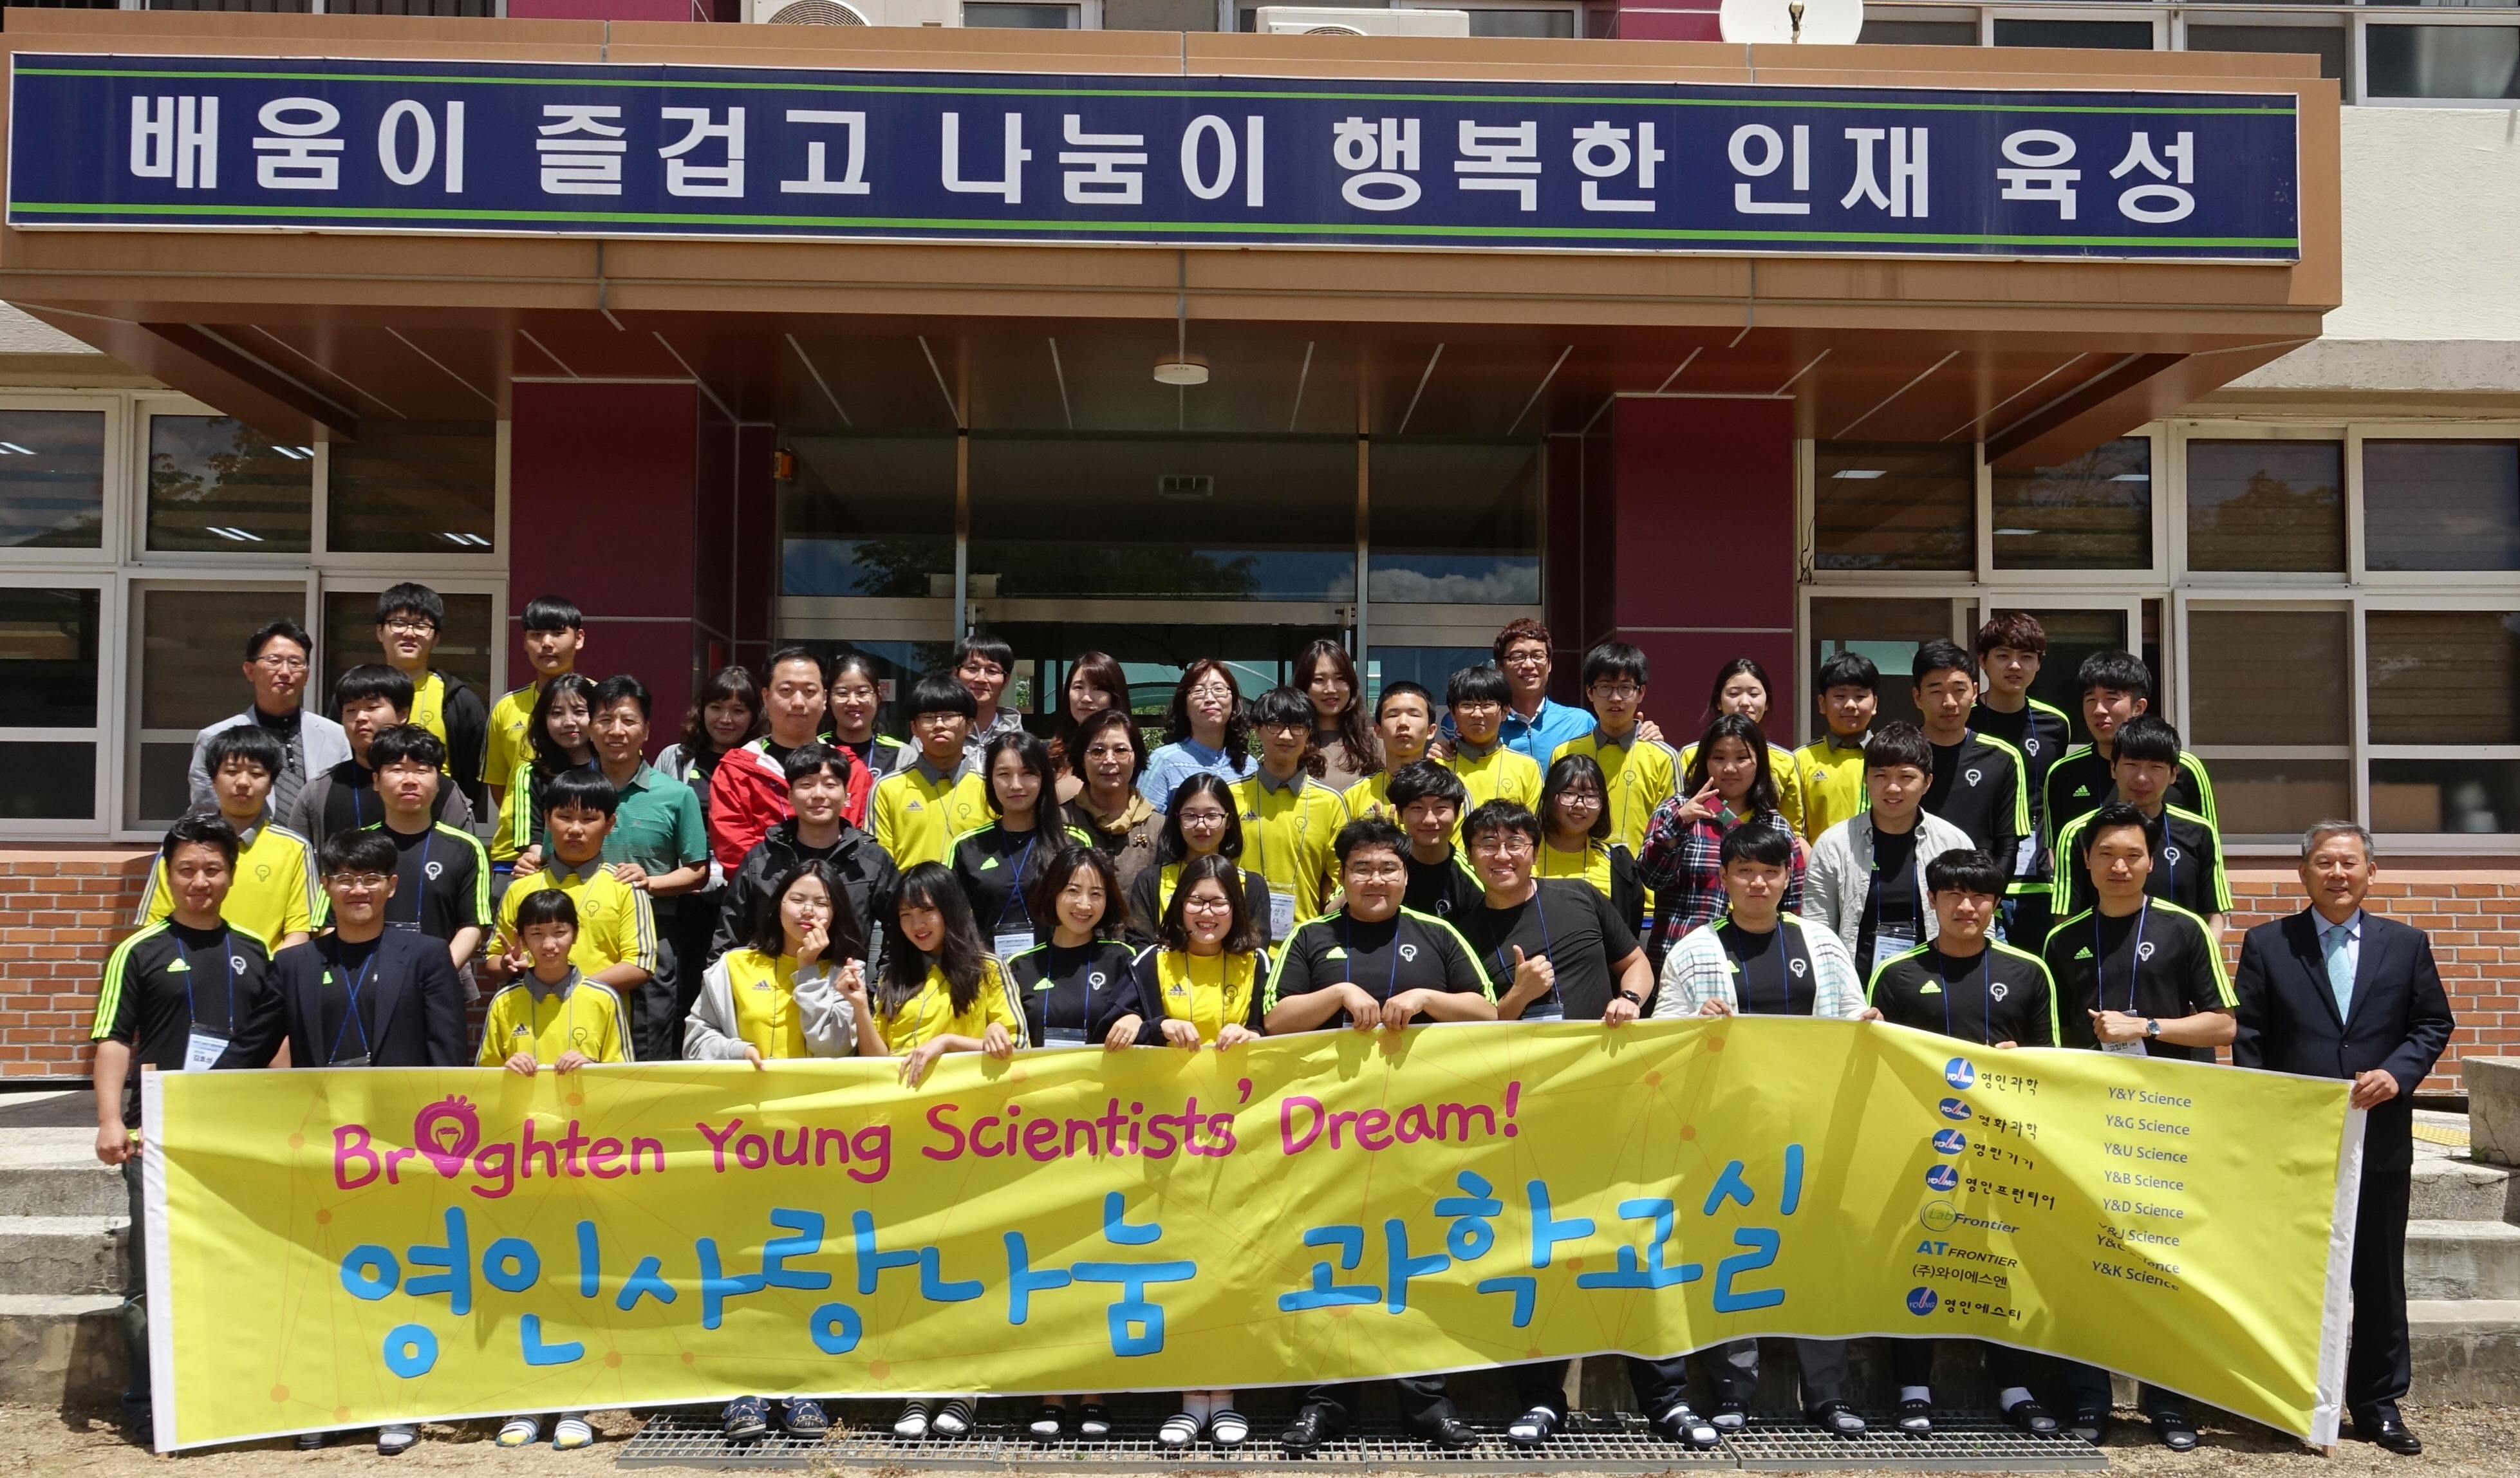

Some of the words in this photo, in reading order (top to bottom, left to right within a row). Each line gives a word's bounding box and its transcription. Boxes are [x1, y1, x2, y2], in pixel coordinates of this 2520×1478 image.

[129, 95, 465, 193] 배움이
[535, 104, 871, 198] 즐겁고
[940, 111, 1265, 207] 나눔이
[1332, 116, 1666, 212] 행복한
[1727, 122, 1930, 218] 인재
[1996, 129, 2196, 224] 육성
[1981, 1072, 2039, 1096] 영인과학
[2109, 1087, 2136, 1101] Y&Y
[2139, 1090, 2192, 1107] Science
[696, 1118, 892, 1184] Young
[1280, 1080, 1522, 1157] Dream!
[1978, 1114, 2038, 1140] 영화과학
[2105, 1114, 2134, 1129] Y&G
[2138, 1118, 2190, 1136] Science
[1974, 1143, 2033, 1170] 영린기기
[2104, 1142, 2133, 1157] Y&U
[2136, 1146, 2188, 1163] Science
[2104, 1170, 2131, 1184] Y&B
[2134, 1174, 2184, 1191] Science
[1965, 1177, 2055, 1211] 영인프런티어
[2103, 1198, 2131, 1212] Y&D
[2134, 1202, 2184, 1219] Science
[1278, 1143, 1804, 1329] 과학교실
[2127, 1229, 2180, 1247] Science
[1916, 1240, 1950, 1256] AT
[1948, 1248, 2018, 1268] FRONTIER
[1912, 1264, 2008, 1289] (주)와이에스엔
[2092, 1260, 2123, 1278] Y&K
[2125, 1268, 2179, 1292] Science
[1945, 1298, 2021, 1321] 영인에스티
